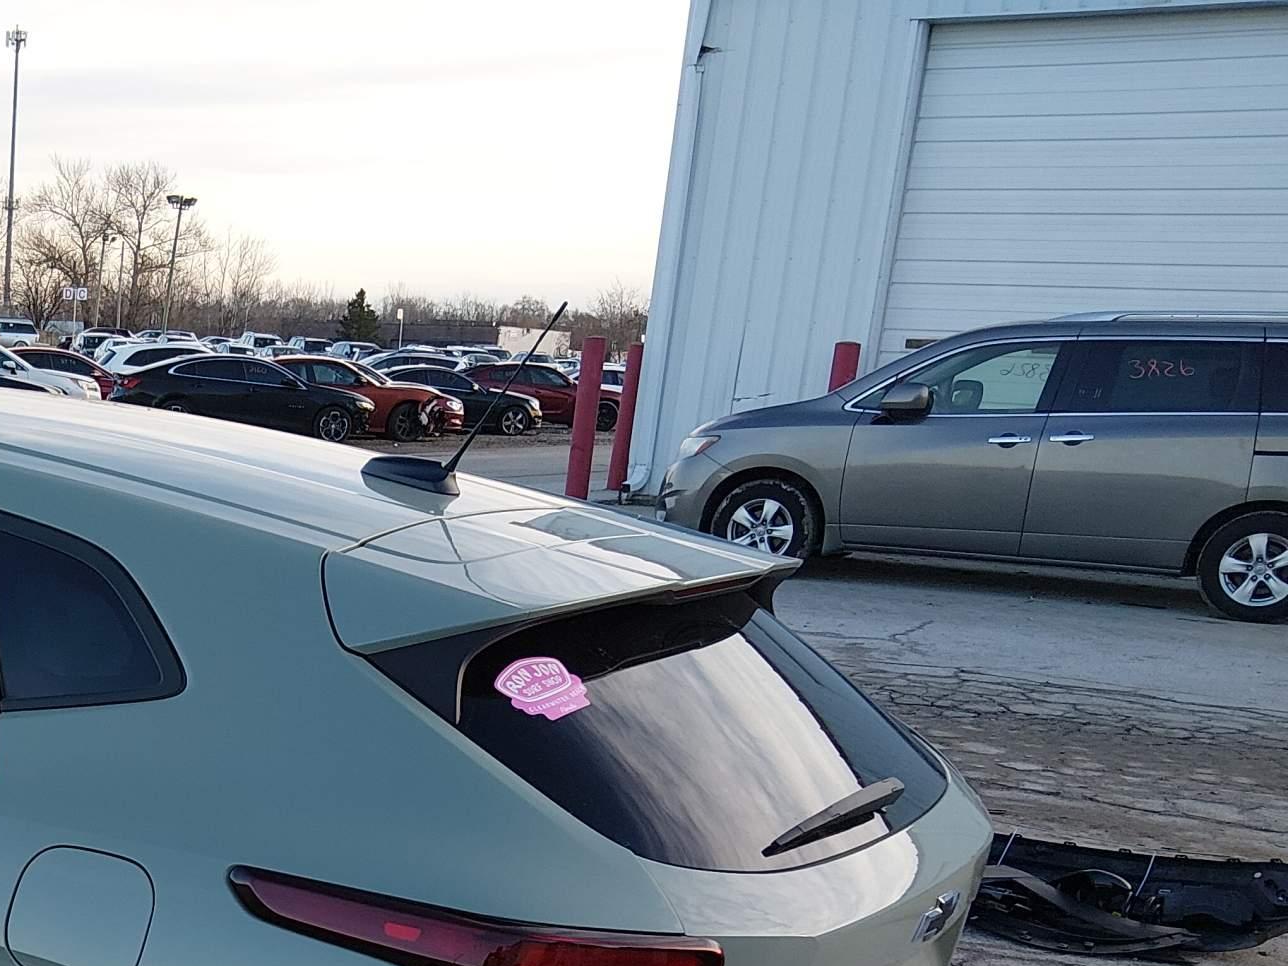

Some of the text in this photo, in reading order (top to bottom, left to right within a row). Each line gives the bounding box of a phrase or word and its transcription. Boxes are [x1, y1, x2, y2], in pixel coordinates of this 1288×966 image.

[65, 288, 72, 299] D
[78, 289, 86, 300] C
[1127, 358, 1195, 379] 3826
[505, 662, 561, 693] RON JON
[522, 674, 563, 697] SURF SHOP
